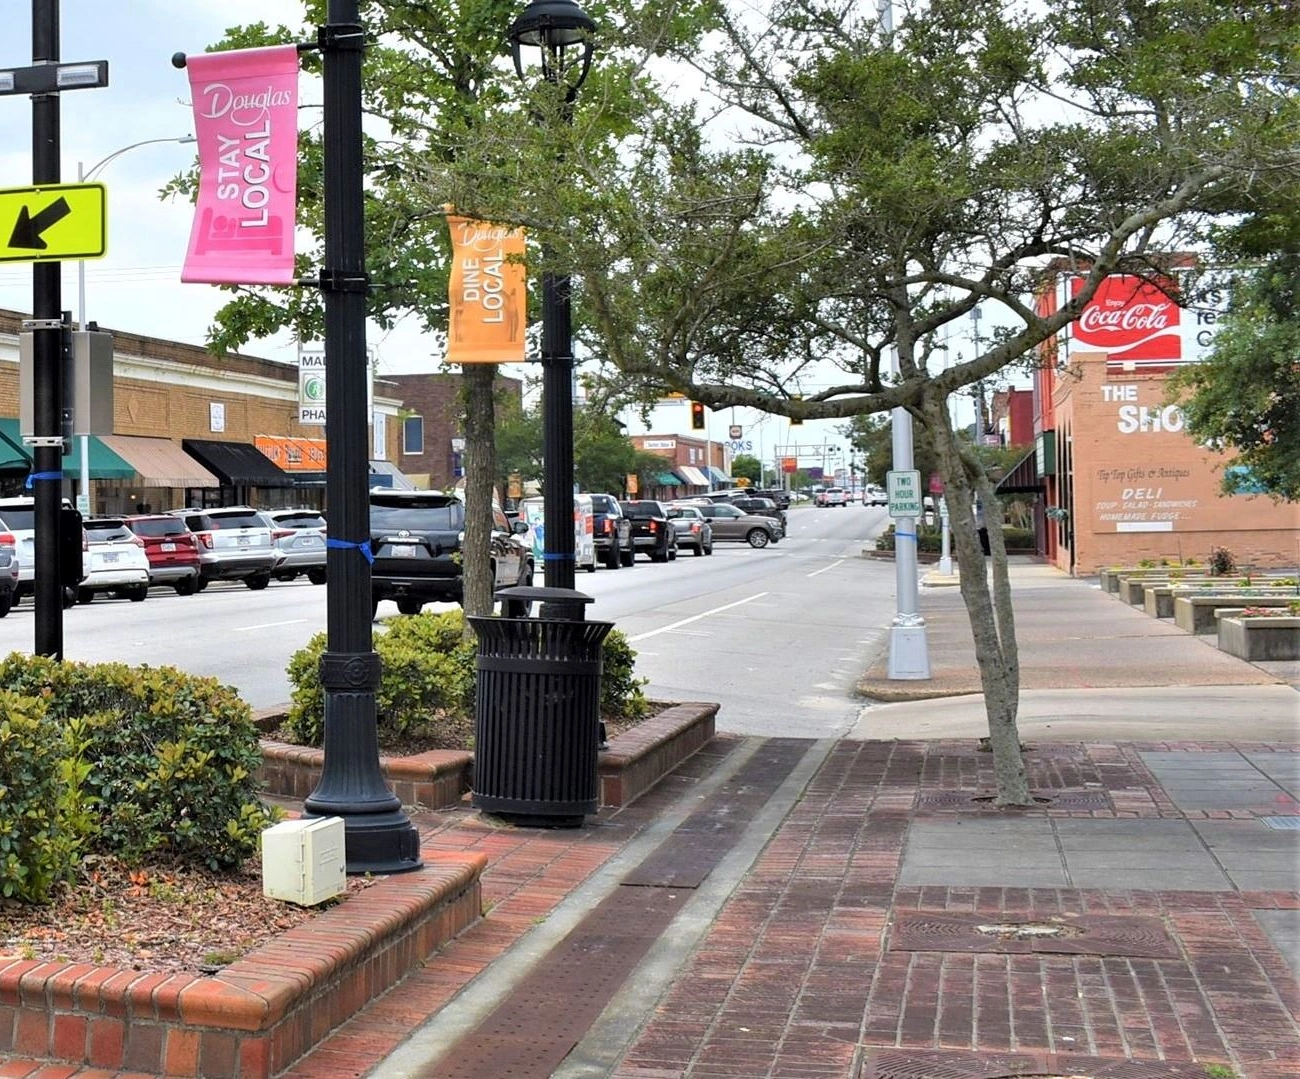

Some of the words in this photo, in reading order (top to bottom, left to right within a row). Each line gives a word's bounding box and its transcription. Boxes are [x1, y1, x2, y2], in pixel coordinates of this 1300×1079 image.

[200, 84, 291, 126] Douglas
[216, 134, 240, 200] STAY
[240, 120, 270, 228] LOCAL
[463, 258, 480, 302] DINE
[482, 249, 504, 323] LOCAL
[1080, 303, 1172, 332] Coca-Cola
[1100, 384, 1139, 401] THE
[302, 409, 327, 421] PHA
[1117, 404, 1184, 434] SHO
[897, 477, 912, 486] TWO
[1127, 467, 1145, 482] Gifts
[1157, 467, 1190, 481] Antiques
[895, 489, 914, 499] HOUR
[1122, 487, 1163, 500] DELI
[891, 502, 919, 511] PARKING
[1100, 512, 1147, 521] HOMEMADE
